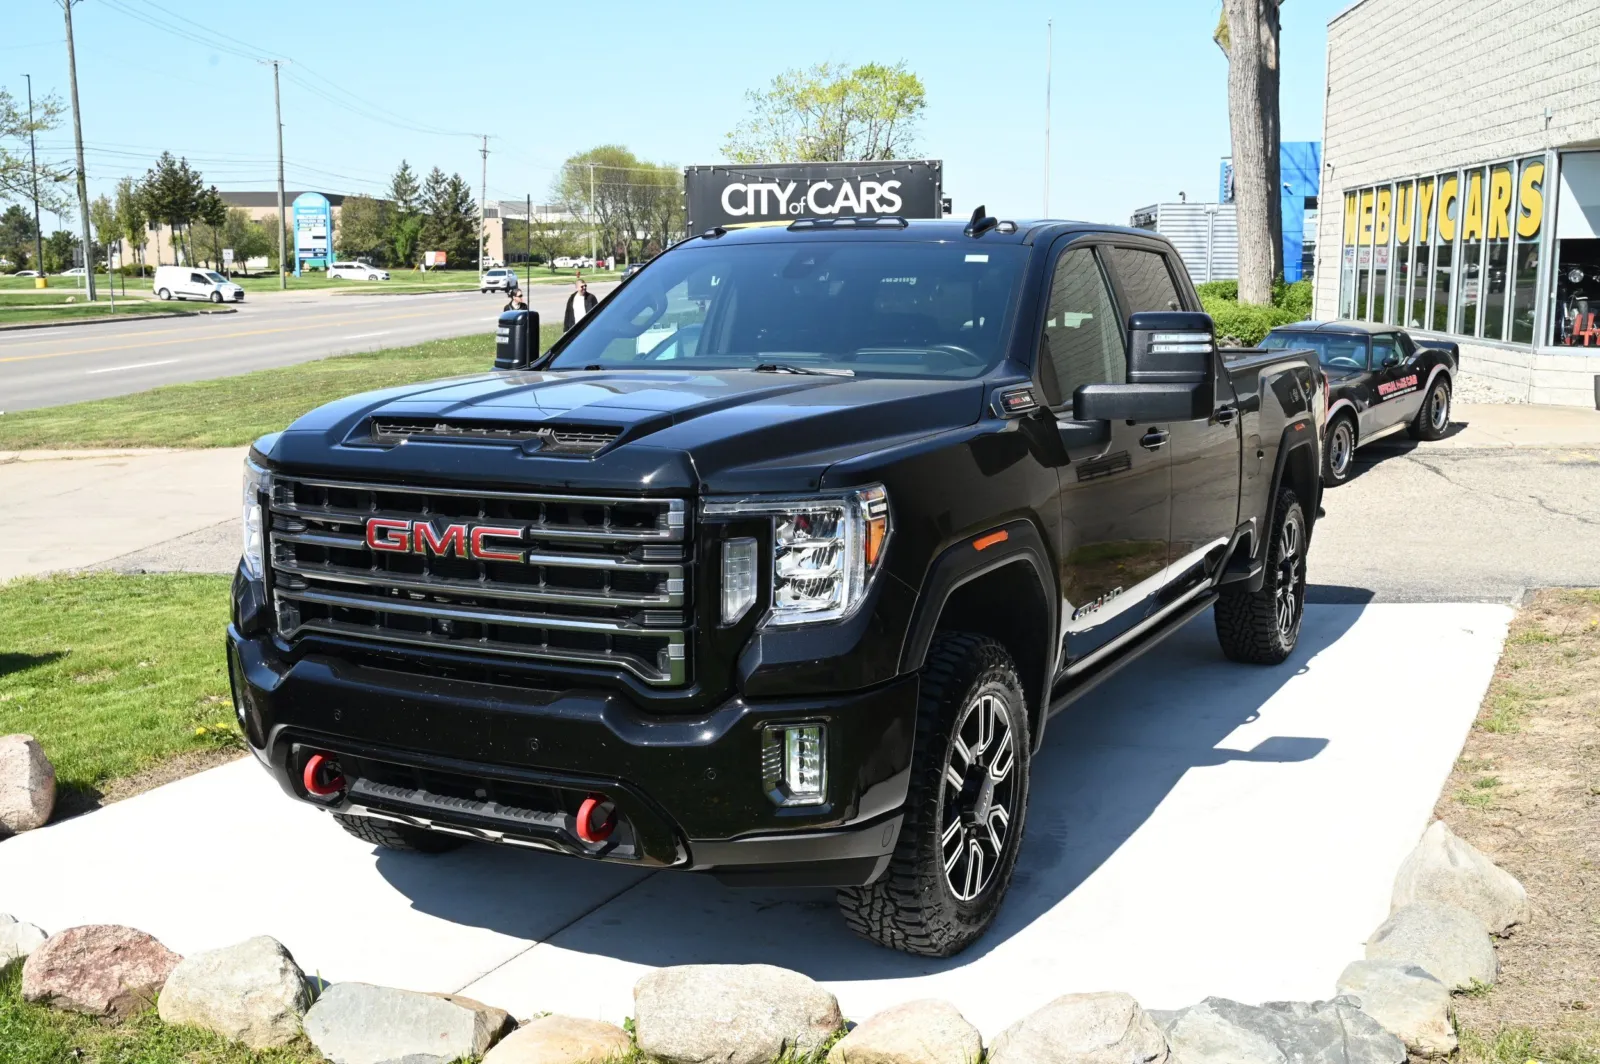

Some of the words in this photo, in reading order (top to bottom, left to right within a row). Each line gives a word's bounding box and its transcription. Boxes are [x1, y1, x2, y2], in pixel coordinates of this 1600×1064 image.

[721, 182, 797, 216] CITY
[789, 196, 806, 215] of
[807, 180, 902, 215] CARS
[366, 517, 525, 564] GMC
